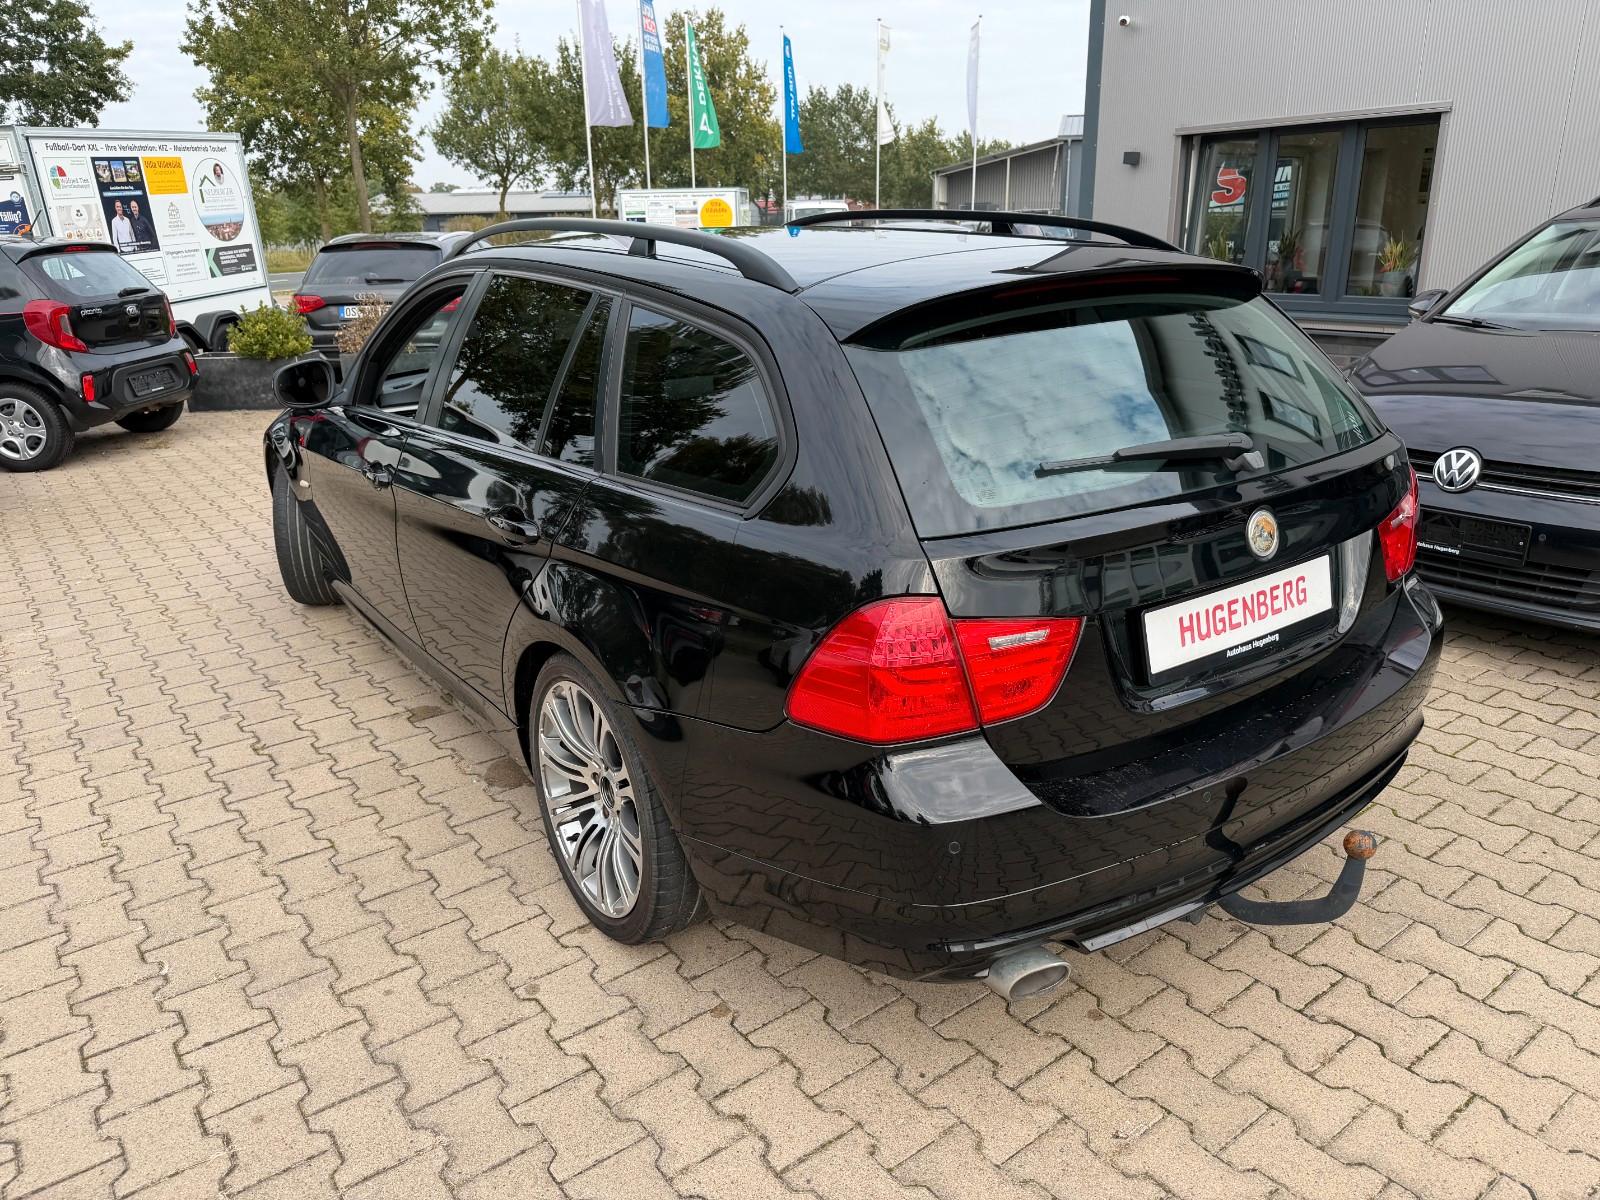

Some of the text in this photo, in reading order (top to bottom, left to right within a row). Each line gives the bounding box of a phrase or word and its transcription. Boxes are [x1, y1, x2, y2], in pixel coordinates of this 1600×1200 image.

[87, 143, 99, 151] XXL
[104, 143, 117, 152] Ihre
[158, 144, 168, 152] KFZ
[173, 144, 208, 152] Meisterbetrieb
[1434, 544, 1460, 555] Hugenberg
[1178, 575, 1308, 648] HUGENBERG
[1226, 632, 1280, 658] Autohaus Hugenberg
